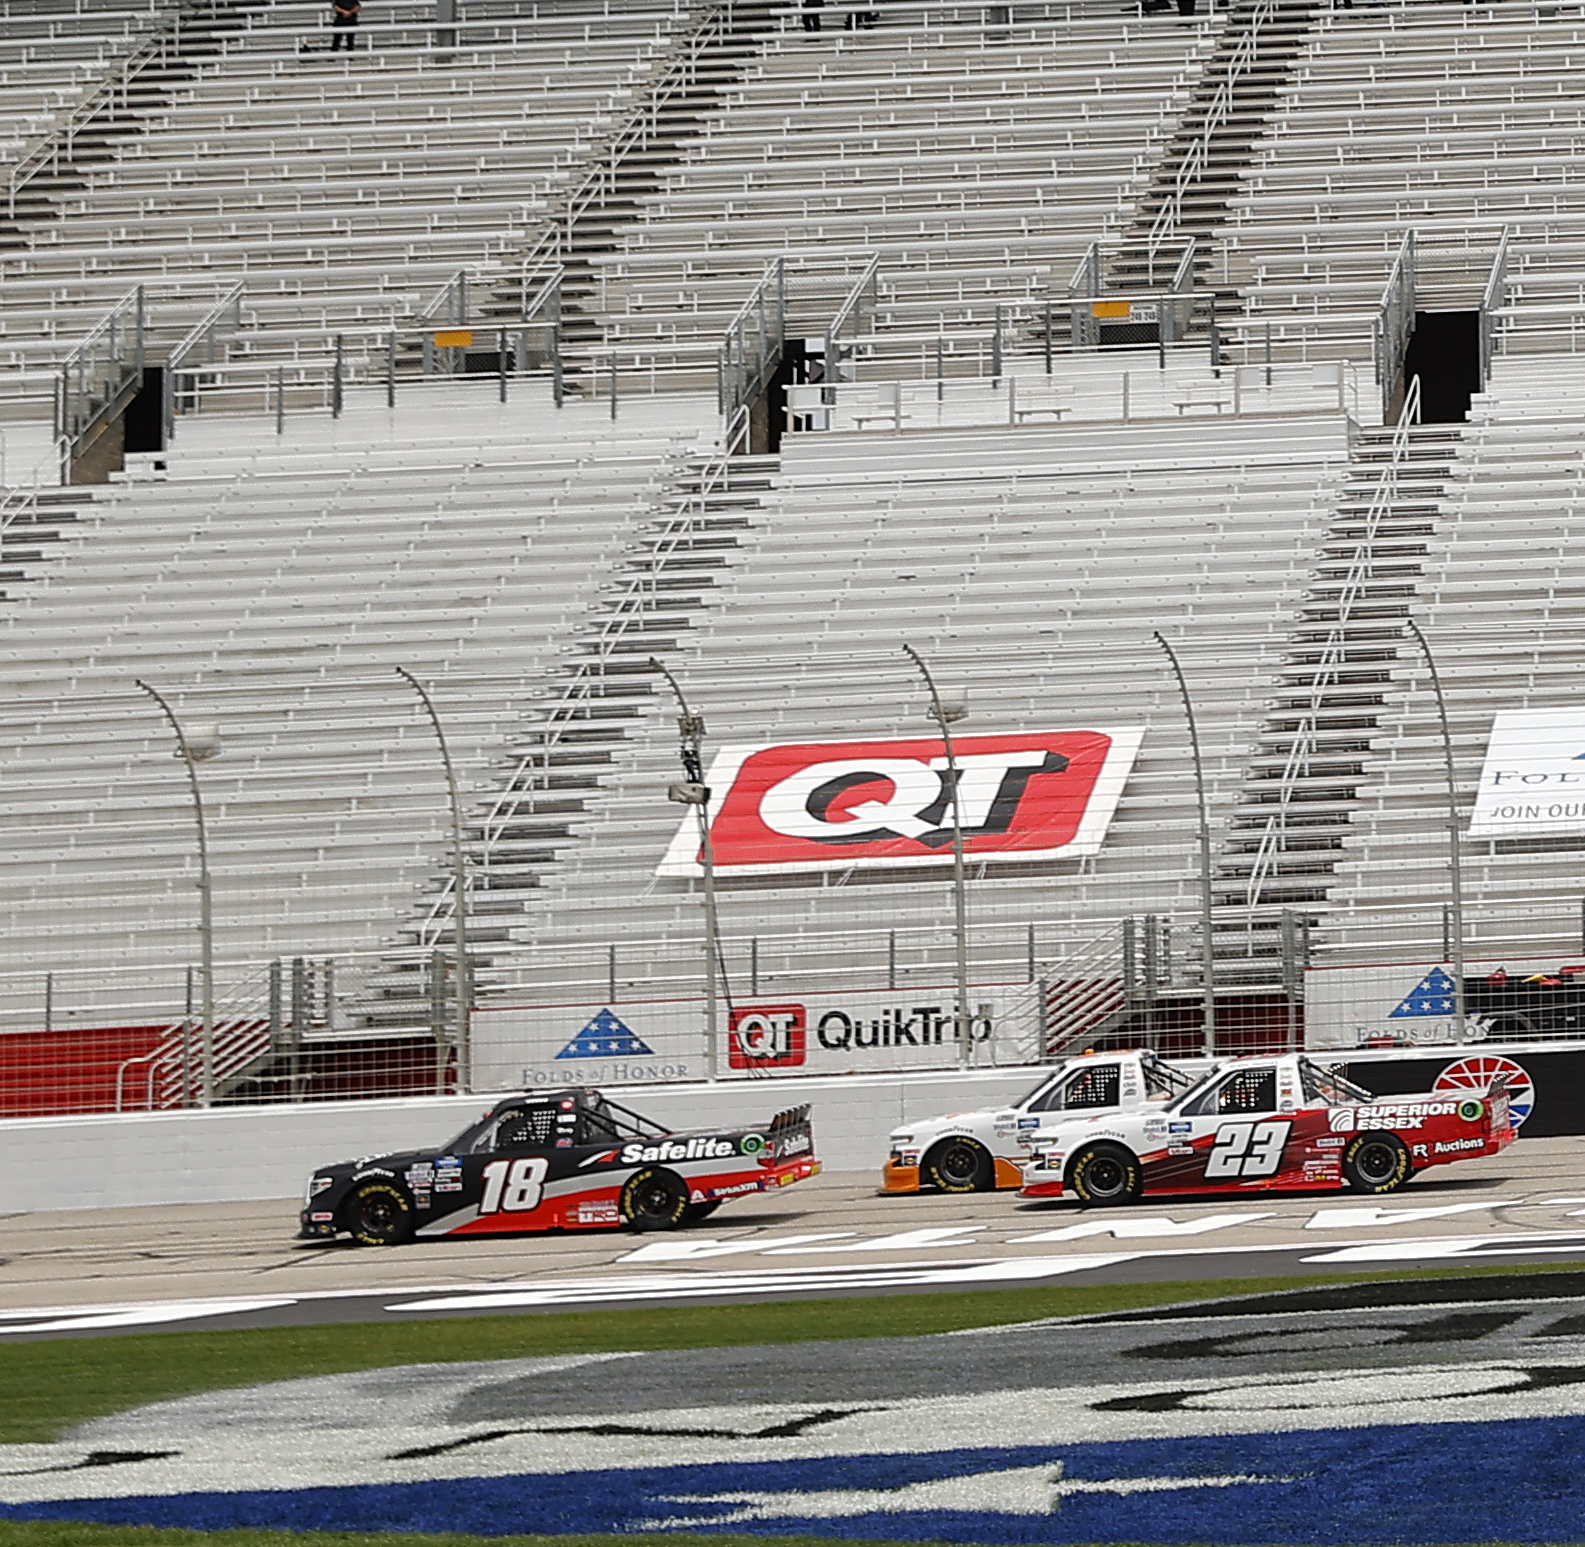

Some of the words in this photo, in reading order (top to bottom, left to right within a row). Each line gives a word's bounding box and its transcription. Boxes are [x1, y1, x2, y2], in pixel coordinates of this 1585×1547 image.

[758, 750, 1048, 838] QT
[1490, 804, 1540, 820] JOIN
[735, 1012, 798, 1060] QT
[521, 1066, 585, 1084] FOLDS
[590, 1063, 608, 1082] of
[613, 1063, 689, 1081] HONOR
[1356, 1102, 1456, 1119] SUPERIOR
[1356, 1116, 1424, 1131] ESSEX
[621, 1137, 733, 1164] Safelite
[1204, 1120, 1292, 1179] 23
[479, 1157, 549, 1215] 18
